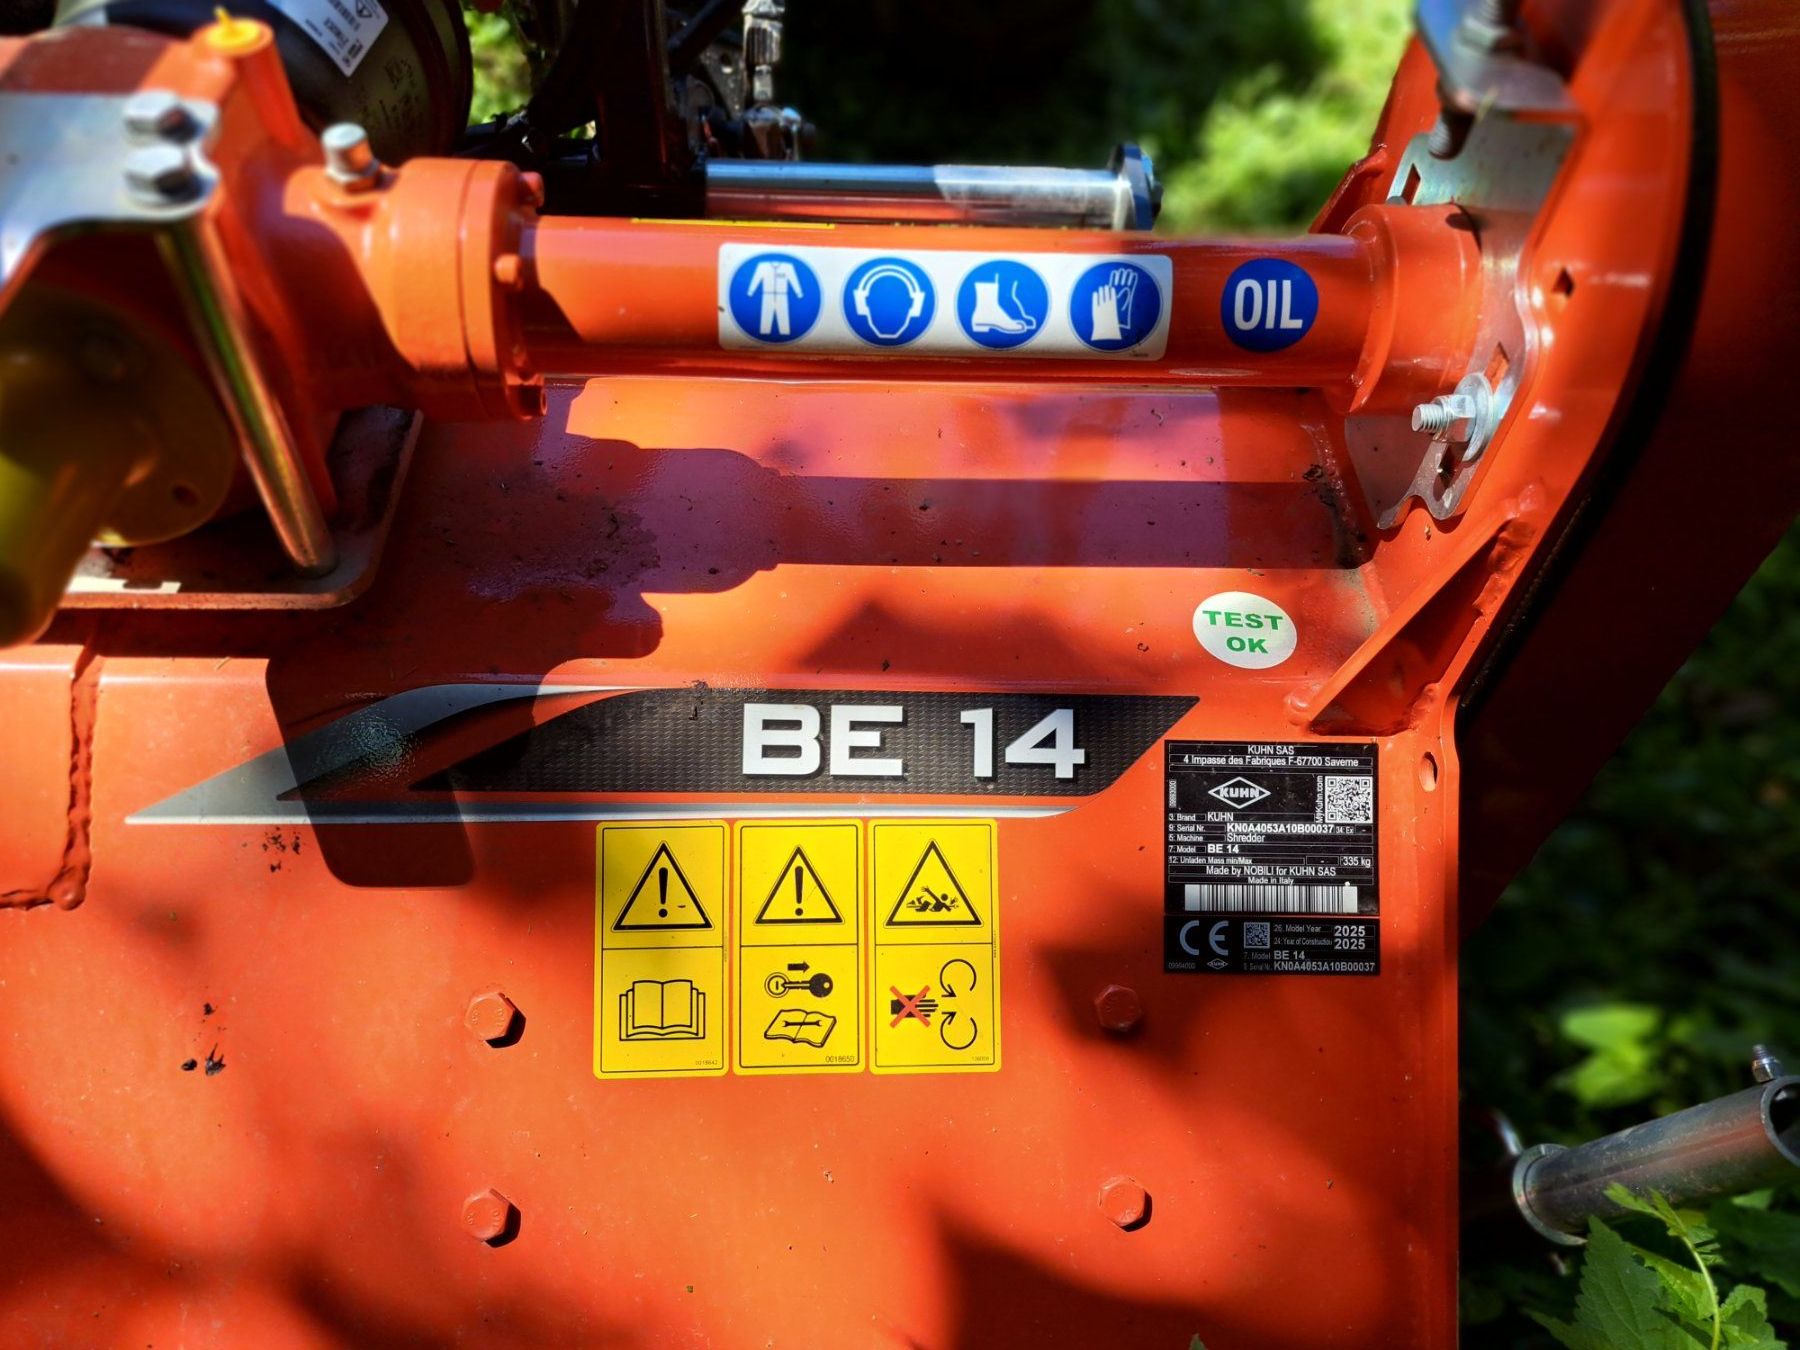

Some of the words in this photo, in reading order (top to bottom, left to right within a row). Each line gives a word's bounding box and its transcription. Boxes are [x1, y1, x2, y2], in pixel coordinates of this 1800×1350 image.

[1234, 278, 1303, 331] OIL
[1202, 610, 1284, 630] TEST
[1226, 636, 1268, 654] OK
[742, 703, 903, 776] BE
[960, 708, 1085, 779] 14
[1247, 745, 1274, 755] KUHN
[1276, 745, 1294, 755] SAS
[1183, 754, 1189, 764] 4
[1191, 755, 1226, 766] Impasse
[1228, 755, 1244, 765] des
[1245, 756, 1286, 767] Fabriques
[1288, 756, 1322, 766] F-67700
[1324, 757, 1359, 767] Saverne
[1220, 787, 1260, 798] KUHN
[1315, 775, 1325, 824] MyKuhn.com
[1177, 813, 1196, 821] Brand
[1207, 812, 1234, 821] KUHN
[1177, 824, 1195, 832] Serial
[1196, 824, 1206, 832] Nr.
[1226, 822, 1334, 834] KN0A4053A10B00037
[1345, 826, 1354, 834] Ex
[1177, 834, 1204, 842] Machine
[1226, 832, 1265, 842] Shredder
[1177, 845, 1196, 853] Model
[1207, 844, 1223, 853] BE
[1226, 844, 1239, 854] 14
[1180, 856, 1206, 864] Unladen
[1207, 856, 1225, 864] Mass
[1343, 856, 1359, 866] 335
[1361, 856, 1371, 868] kg
[1206, 865, 1229, 875] Made
[1231, 865, 1241, 877] by
[1243, 865, 1274, 876] NOBILI
[1276, 866, 1287, 876] for
[1289, 866, 1315, 876] KUHN
[1317, 867, 1336, 877] SAS
[1279, 877, 1294, 886] Italy
[1285, 924, 1305, 932] Model
[1306, 924, 1322, 932] Year
[1334, 925, 1366, 937] 2025
[1334, 938, 1366, 950] 2025
[1273, 950, 1290, 960] BE
[1293, 950, 1305, 960] 14
[1273, 961, 1376, 972] KN0A4053A10B00037
